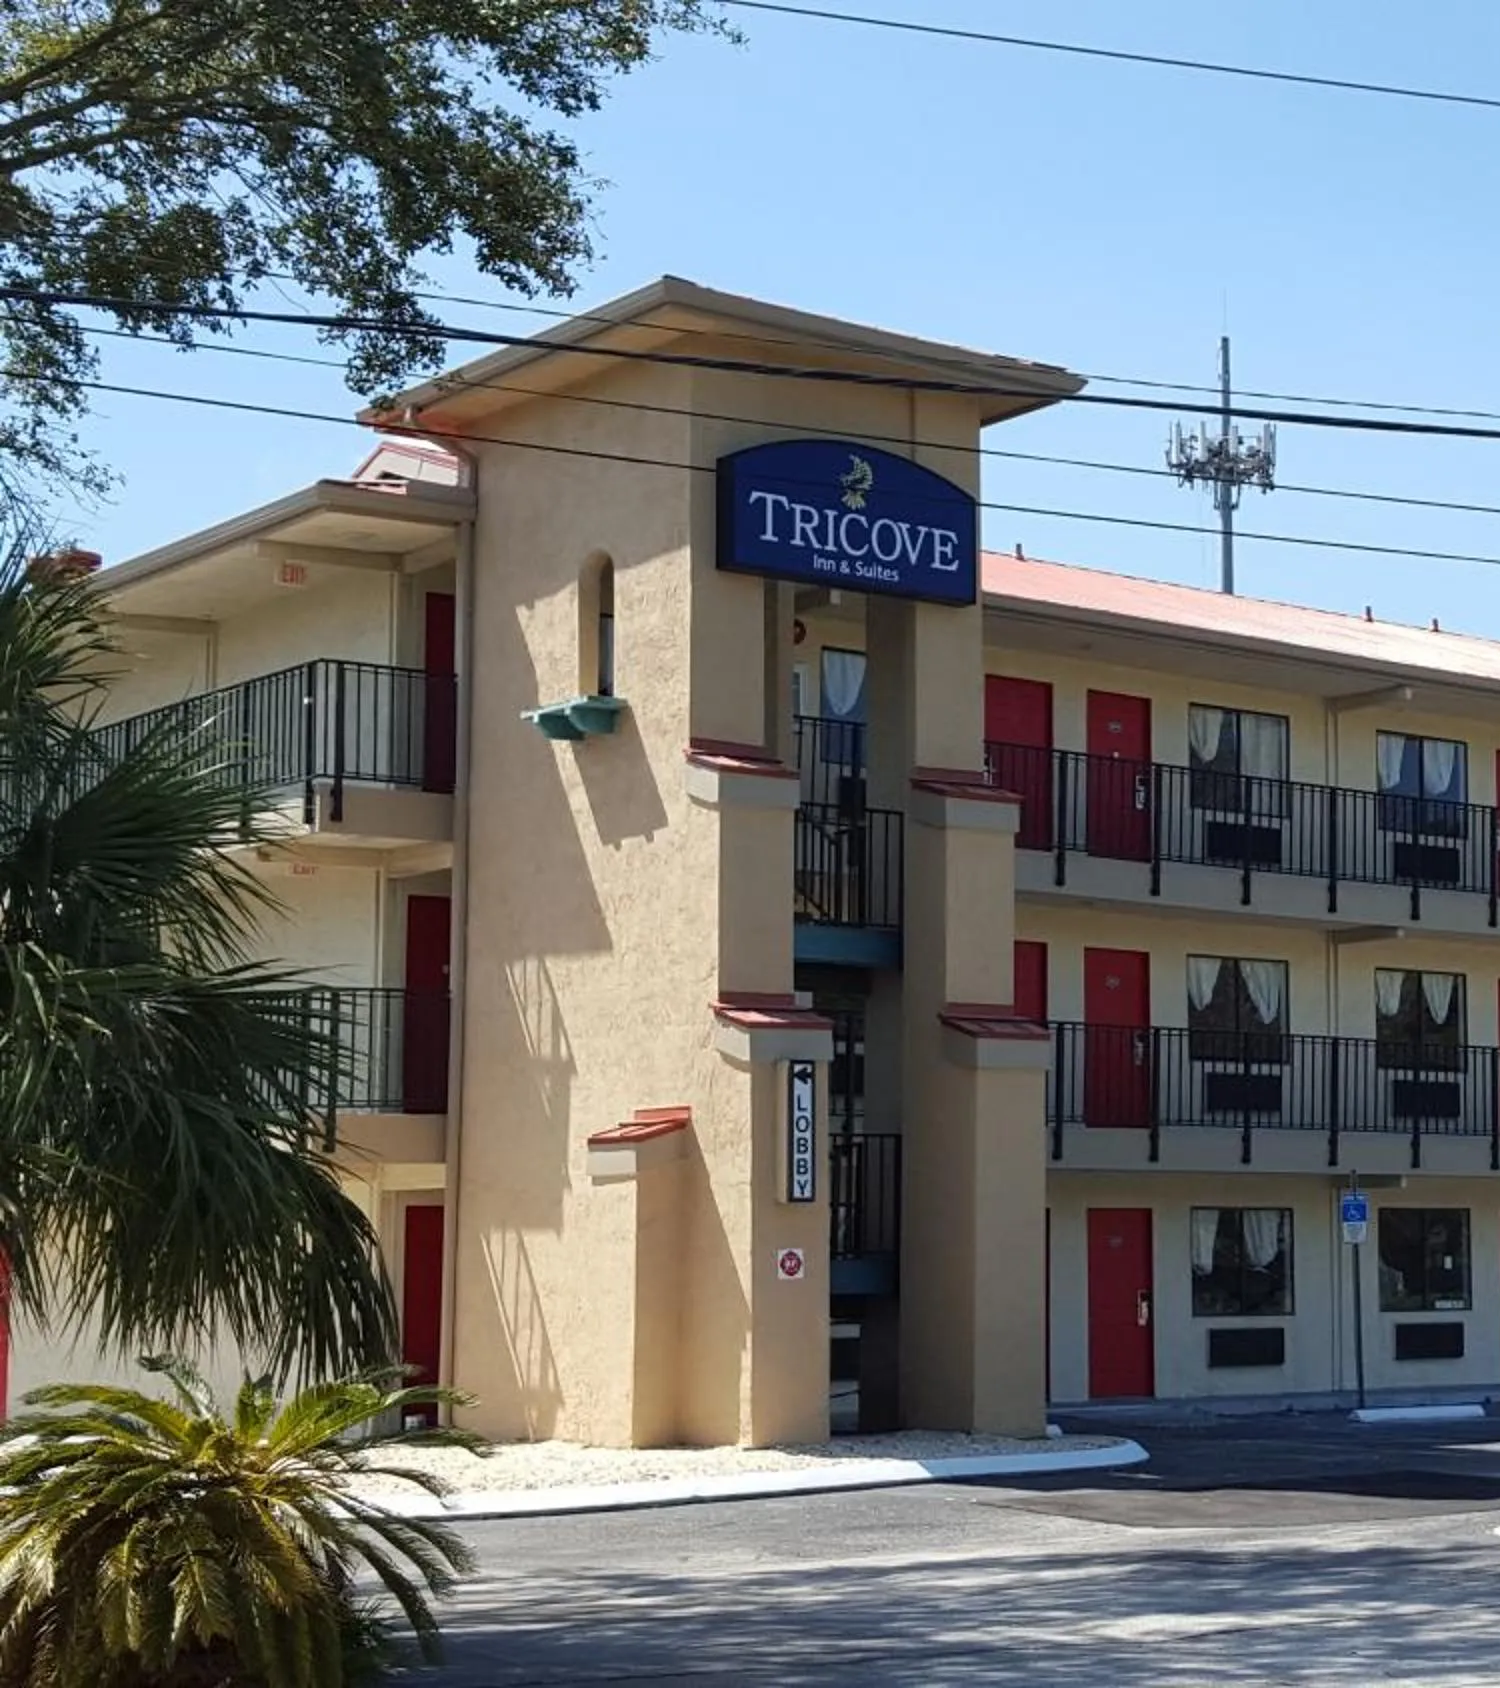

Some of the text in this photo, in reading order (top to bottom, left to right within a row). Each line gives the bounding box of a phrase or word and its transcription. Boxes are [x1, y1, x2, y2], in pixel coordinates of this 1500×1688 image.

[749, 491, 959, 571] TRICOVE
[813, 553, 899, 581] Inn & Suites
[795, 1094, 811, 1195] LOBBY
